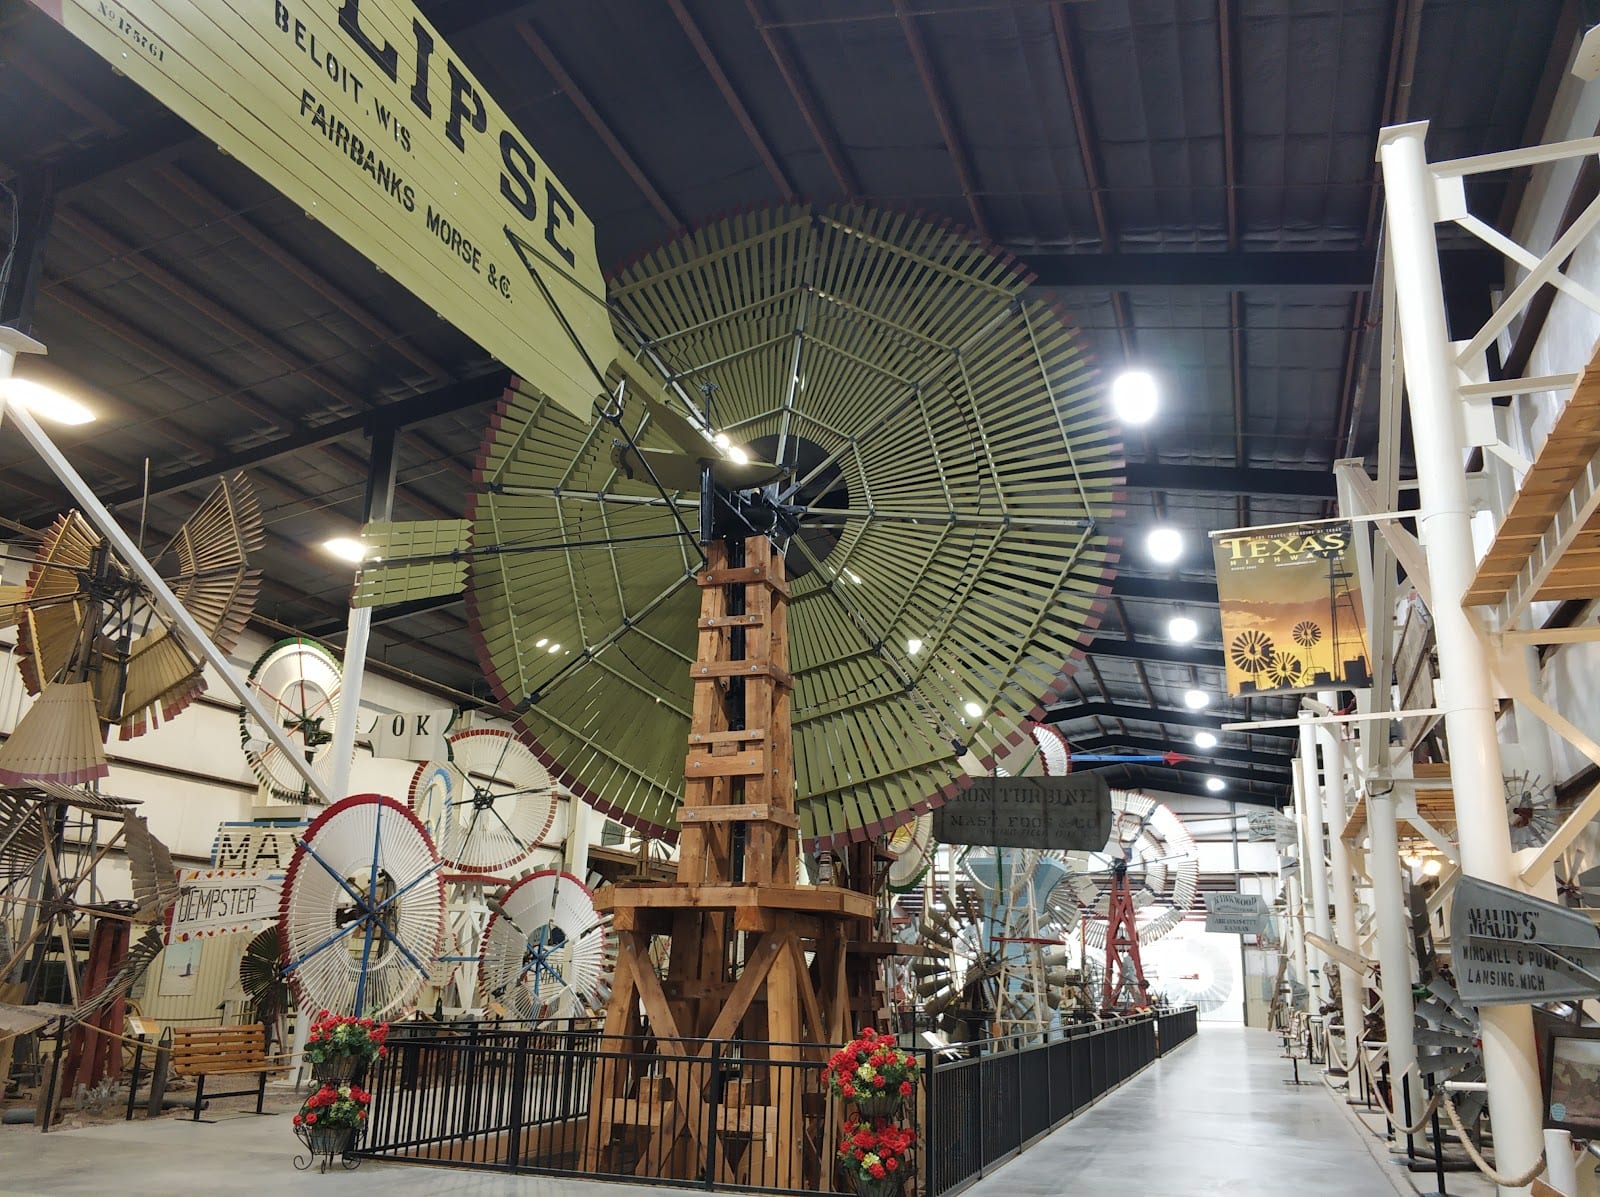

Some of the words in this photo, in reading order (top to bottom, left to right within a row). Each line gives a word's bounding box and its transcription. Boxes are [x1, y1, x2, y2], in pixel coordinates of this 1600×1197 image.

[300, 88, 415, 212] FAIRBANKS
[426, 204, 482, 274] MORSE
[1220, 533, 1345, 560] TEXAS
[1230, 549, 1344, 566] HIGHWAYS
[177, 886, 257, 922] DEMPSTER
[1463, 945, 1512, 964] WINDMILL
[1529, 951, 1559, 971] PUMP
